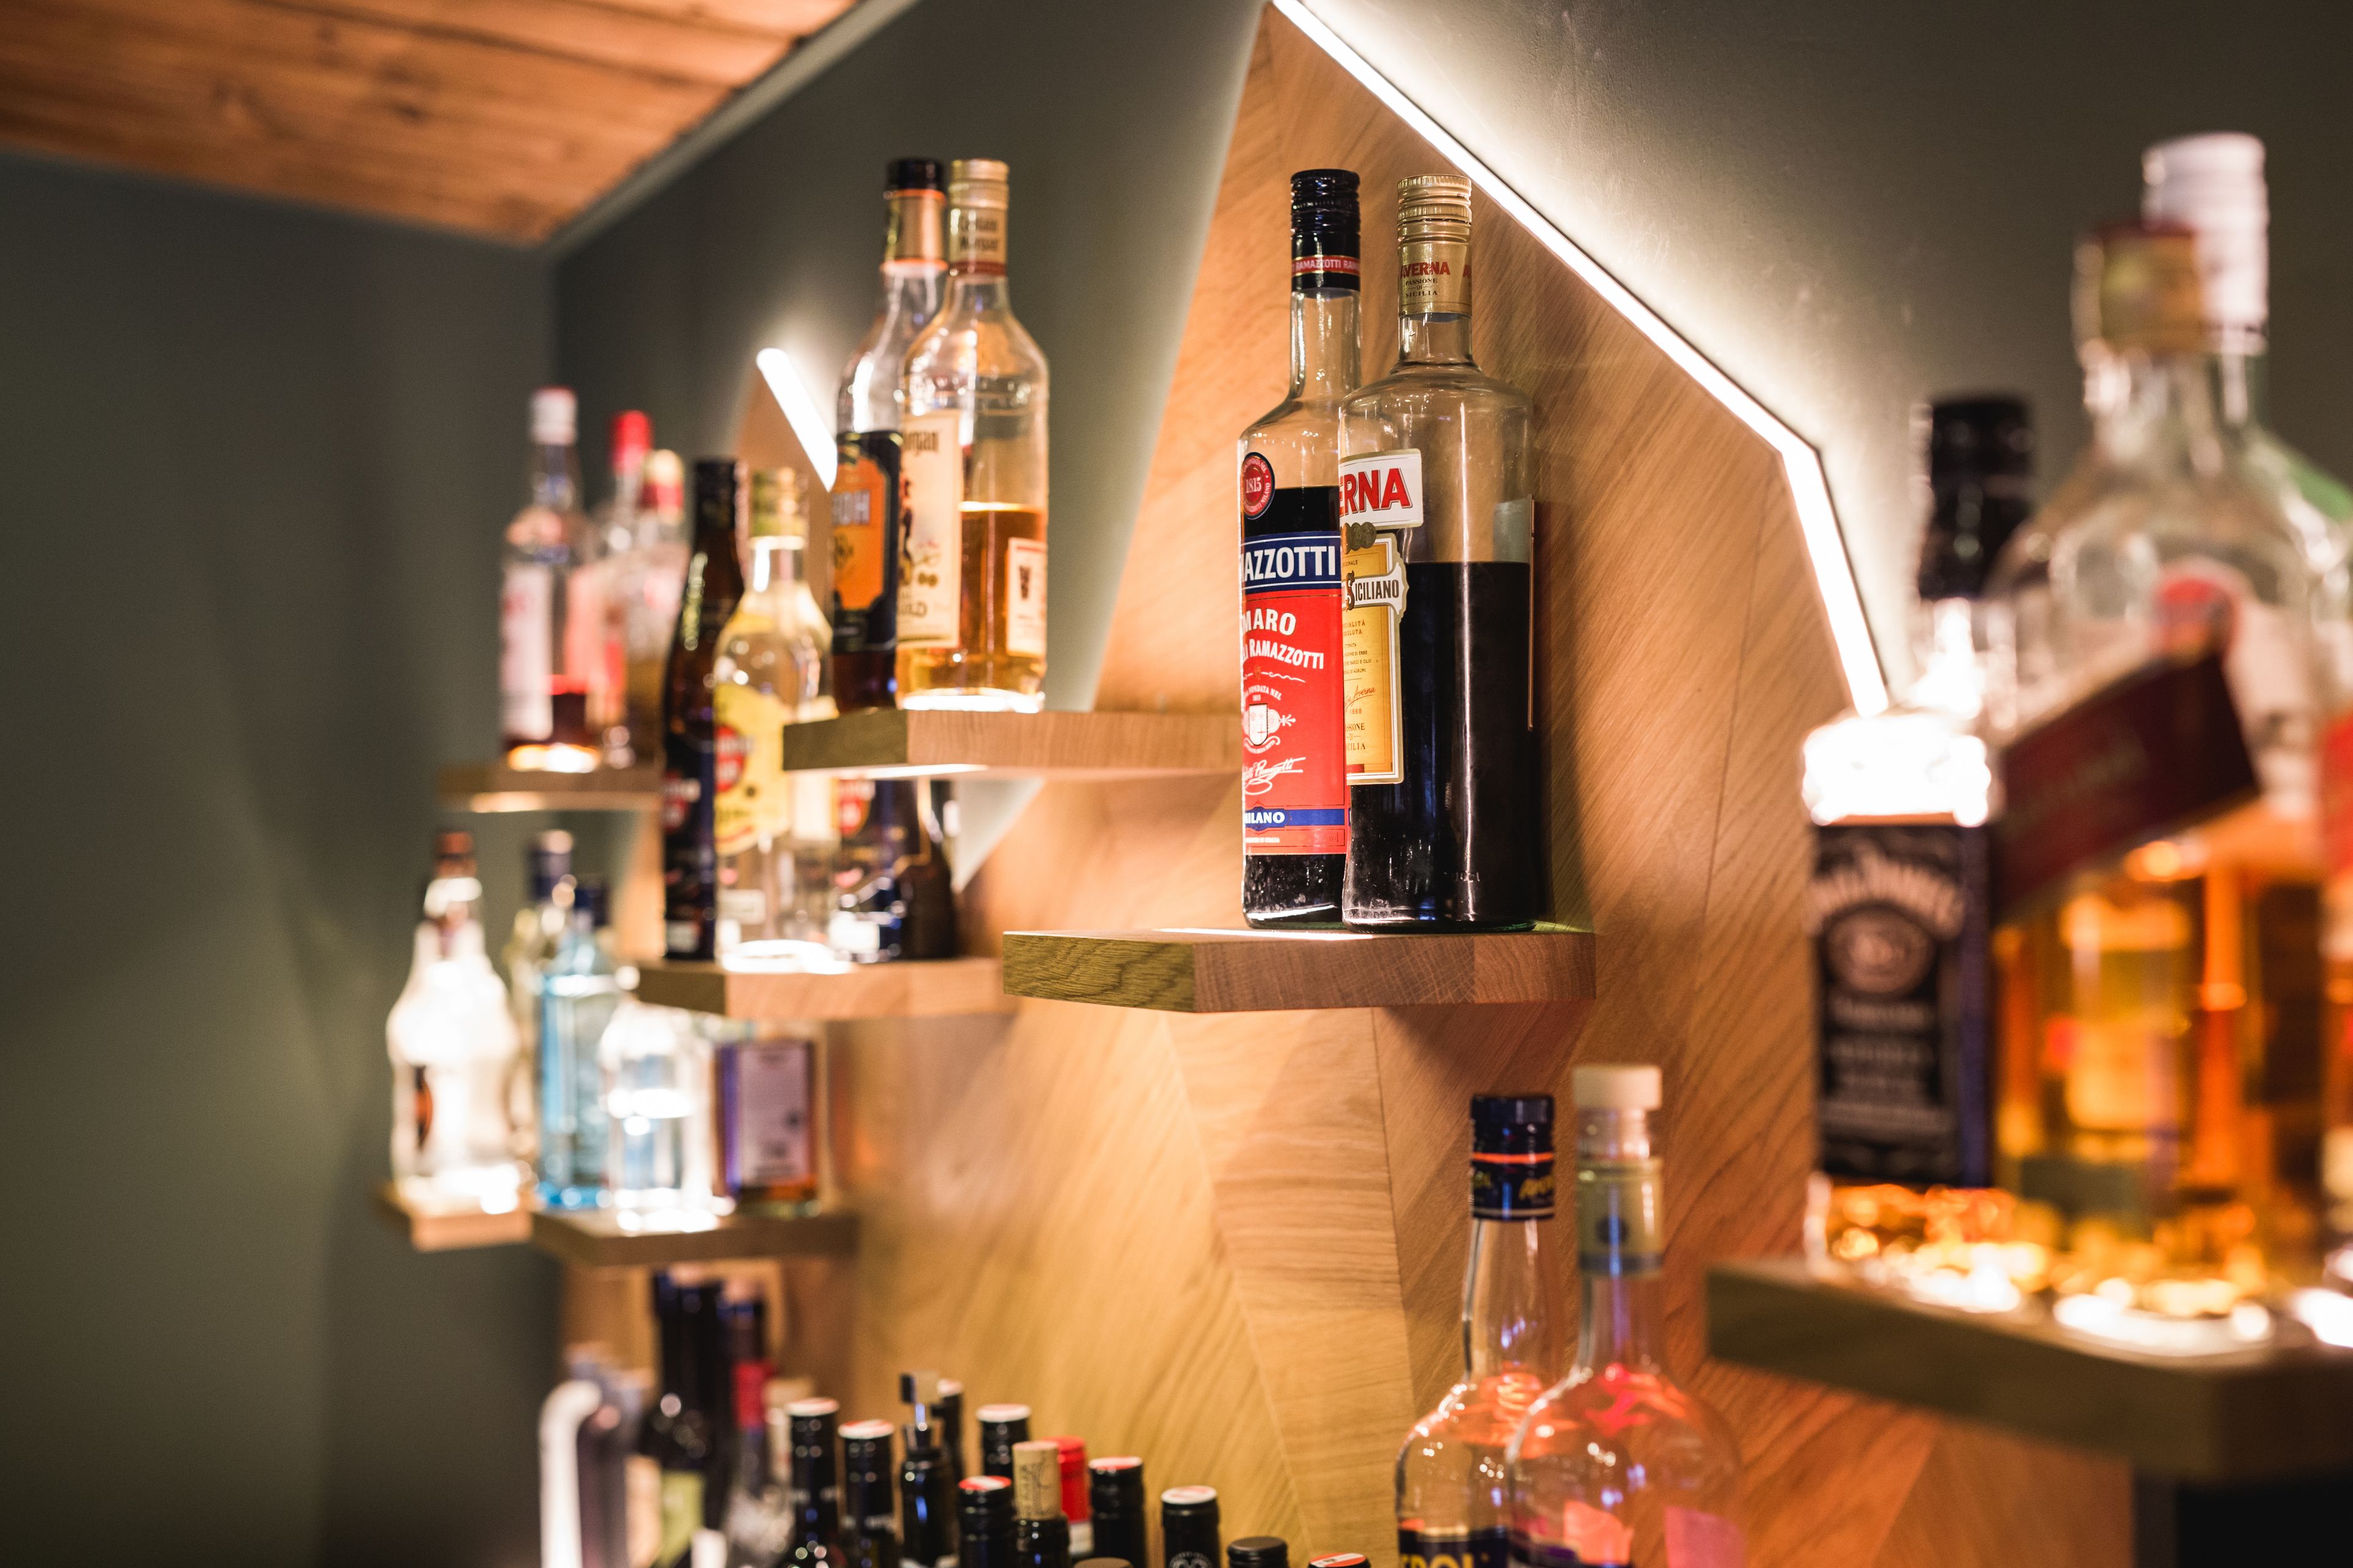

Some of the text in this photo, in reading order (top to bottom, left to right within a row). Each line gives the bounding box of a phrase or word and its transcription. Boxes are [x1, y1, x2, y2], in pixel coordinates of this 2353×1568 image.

[1400, 262, 1450, 279] AVERNA
[1246, 477, 1262, 493] 1815
[1346, 570, 1400, 610] SICILIANO
[1249, 638, 1324, 669] RAMAZZOTTI
[1248, 684, 1282, 700] FONDATA NEL
